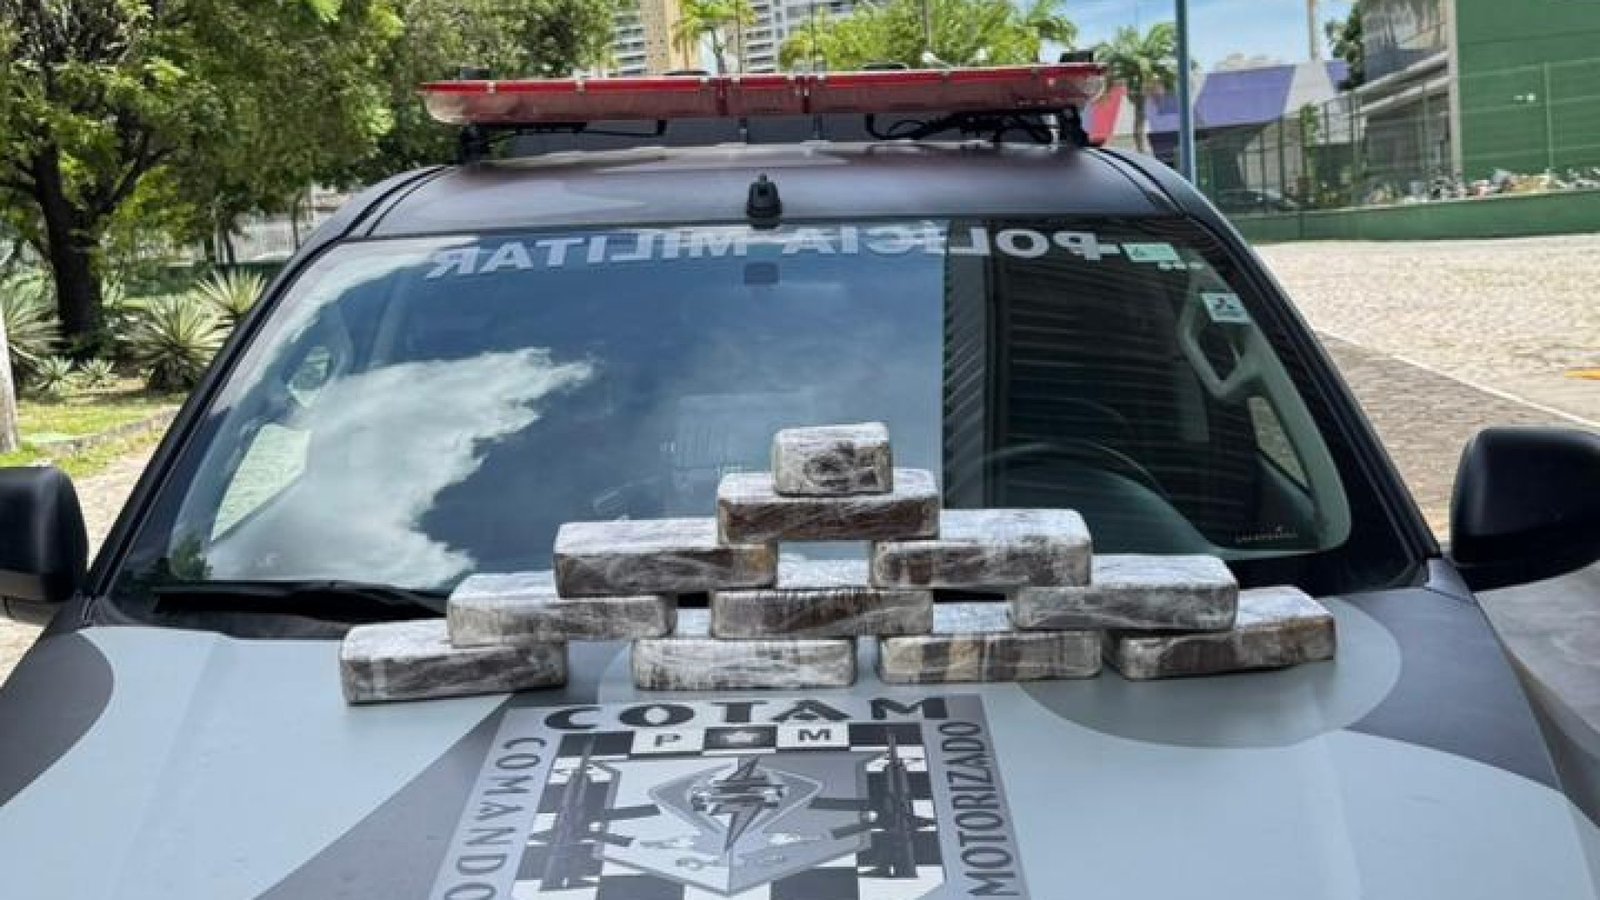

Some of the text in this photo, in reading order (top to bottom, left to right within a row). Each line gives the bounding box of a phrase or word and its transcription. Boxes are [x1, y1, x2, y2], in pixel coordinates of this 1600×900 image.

[544, 699, 948, 730] COTAM
[654, 728, 831, 748] P M
[444, 737, 547, 900] COMANDO
[938, 722, 1020, 896] MOTORIZADO
